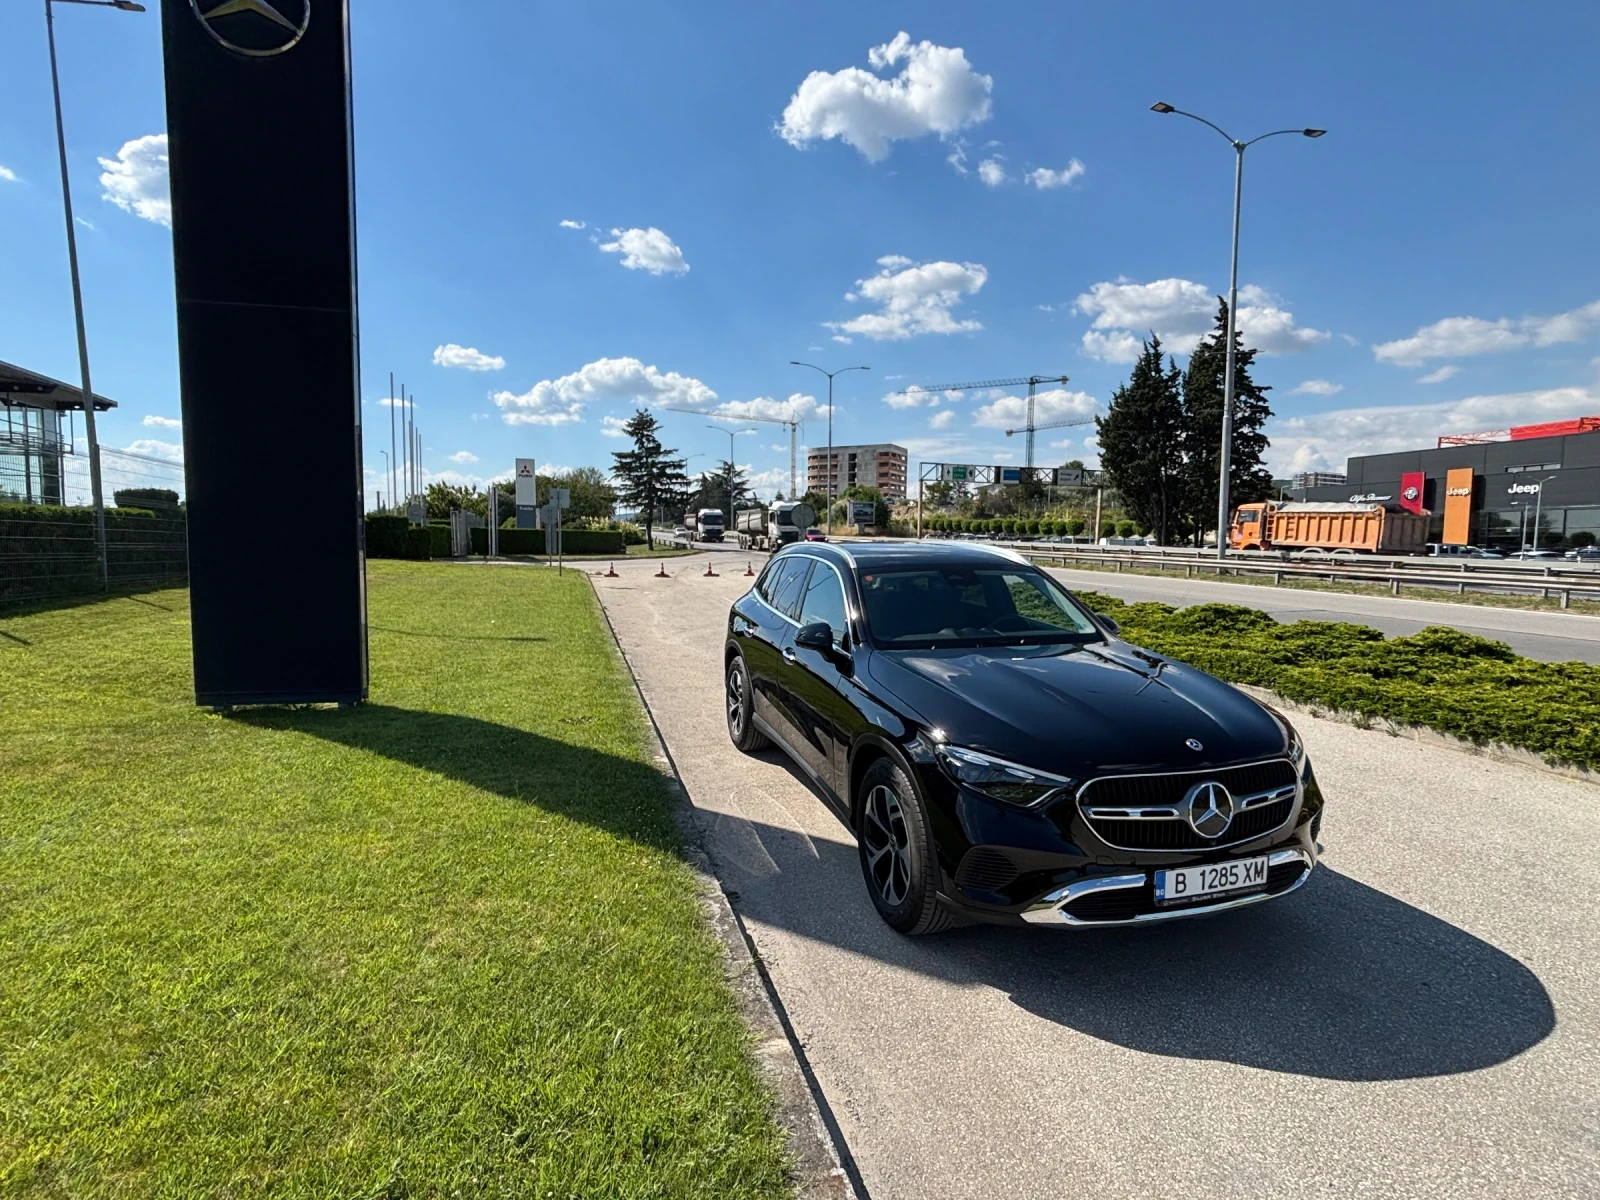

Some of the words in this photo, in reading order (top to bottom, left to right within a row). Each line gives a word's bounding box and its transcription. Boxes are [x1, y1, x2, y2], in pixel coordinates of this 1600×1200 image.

[1447, 487, 1470, 496] Jeep
[1507, 483, 1540, 494] Jeep
[1349, 494, 1366, 504] Alfa
[1366, 493, 1392, 501] Romeo
[1175, 873, 1187, 894] B
[1200, 865, 1239, 890] 1285
[1243, 861, 1265, 884] XM
